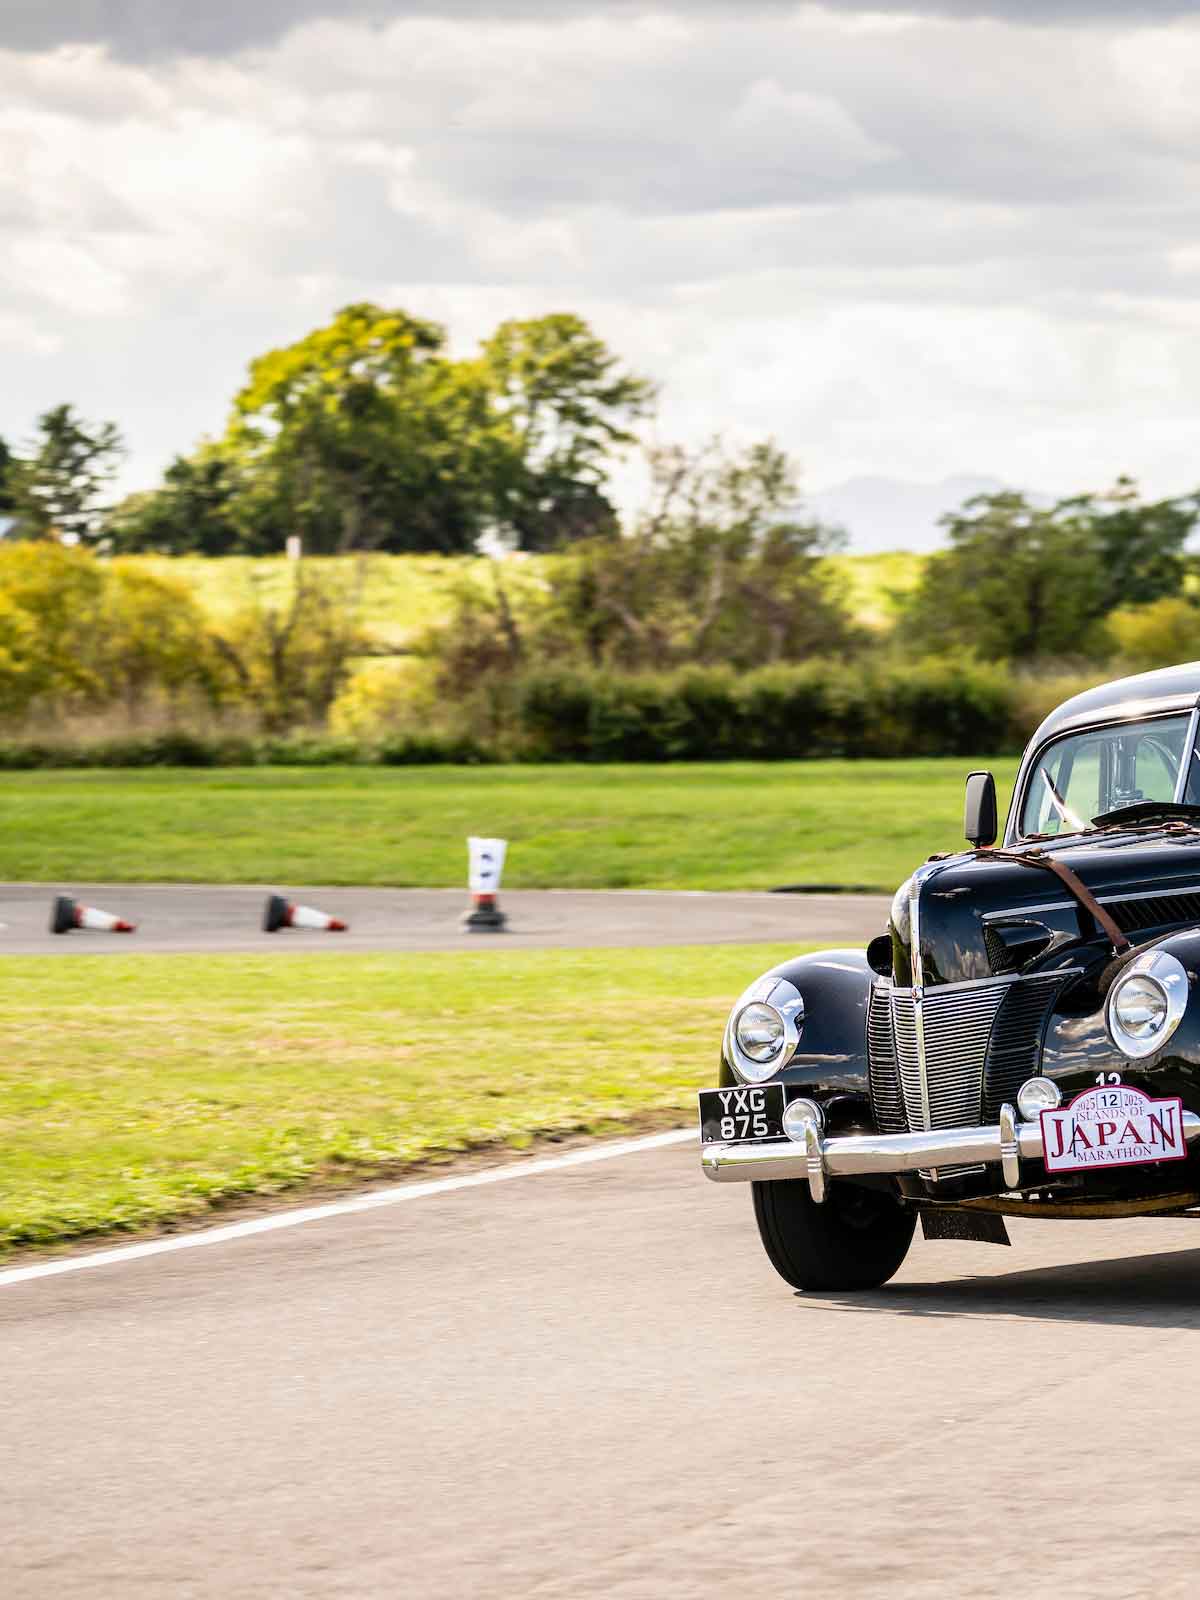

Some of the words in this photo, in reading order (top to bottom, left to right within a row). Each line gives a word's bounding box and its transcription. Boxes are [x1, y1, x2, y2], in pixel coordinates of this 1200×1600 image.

[718, 1089, 766, 1114] YXG
[1076, 1097, 1096, 1111] 2025
[1101, 1094, 1118, 1106] 12
[1123, 1094, 1143, 1107] 2025
[1075, 1109, 1126, 1121] ISLANDS
[1130, 1106, 1145, 1117] OF
[720, 1113, 769, 1140] 875
[1051, 1106, 1176, 1158] JAPAN
[1077, 1145, 1152, 1162] MARATHON
